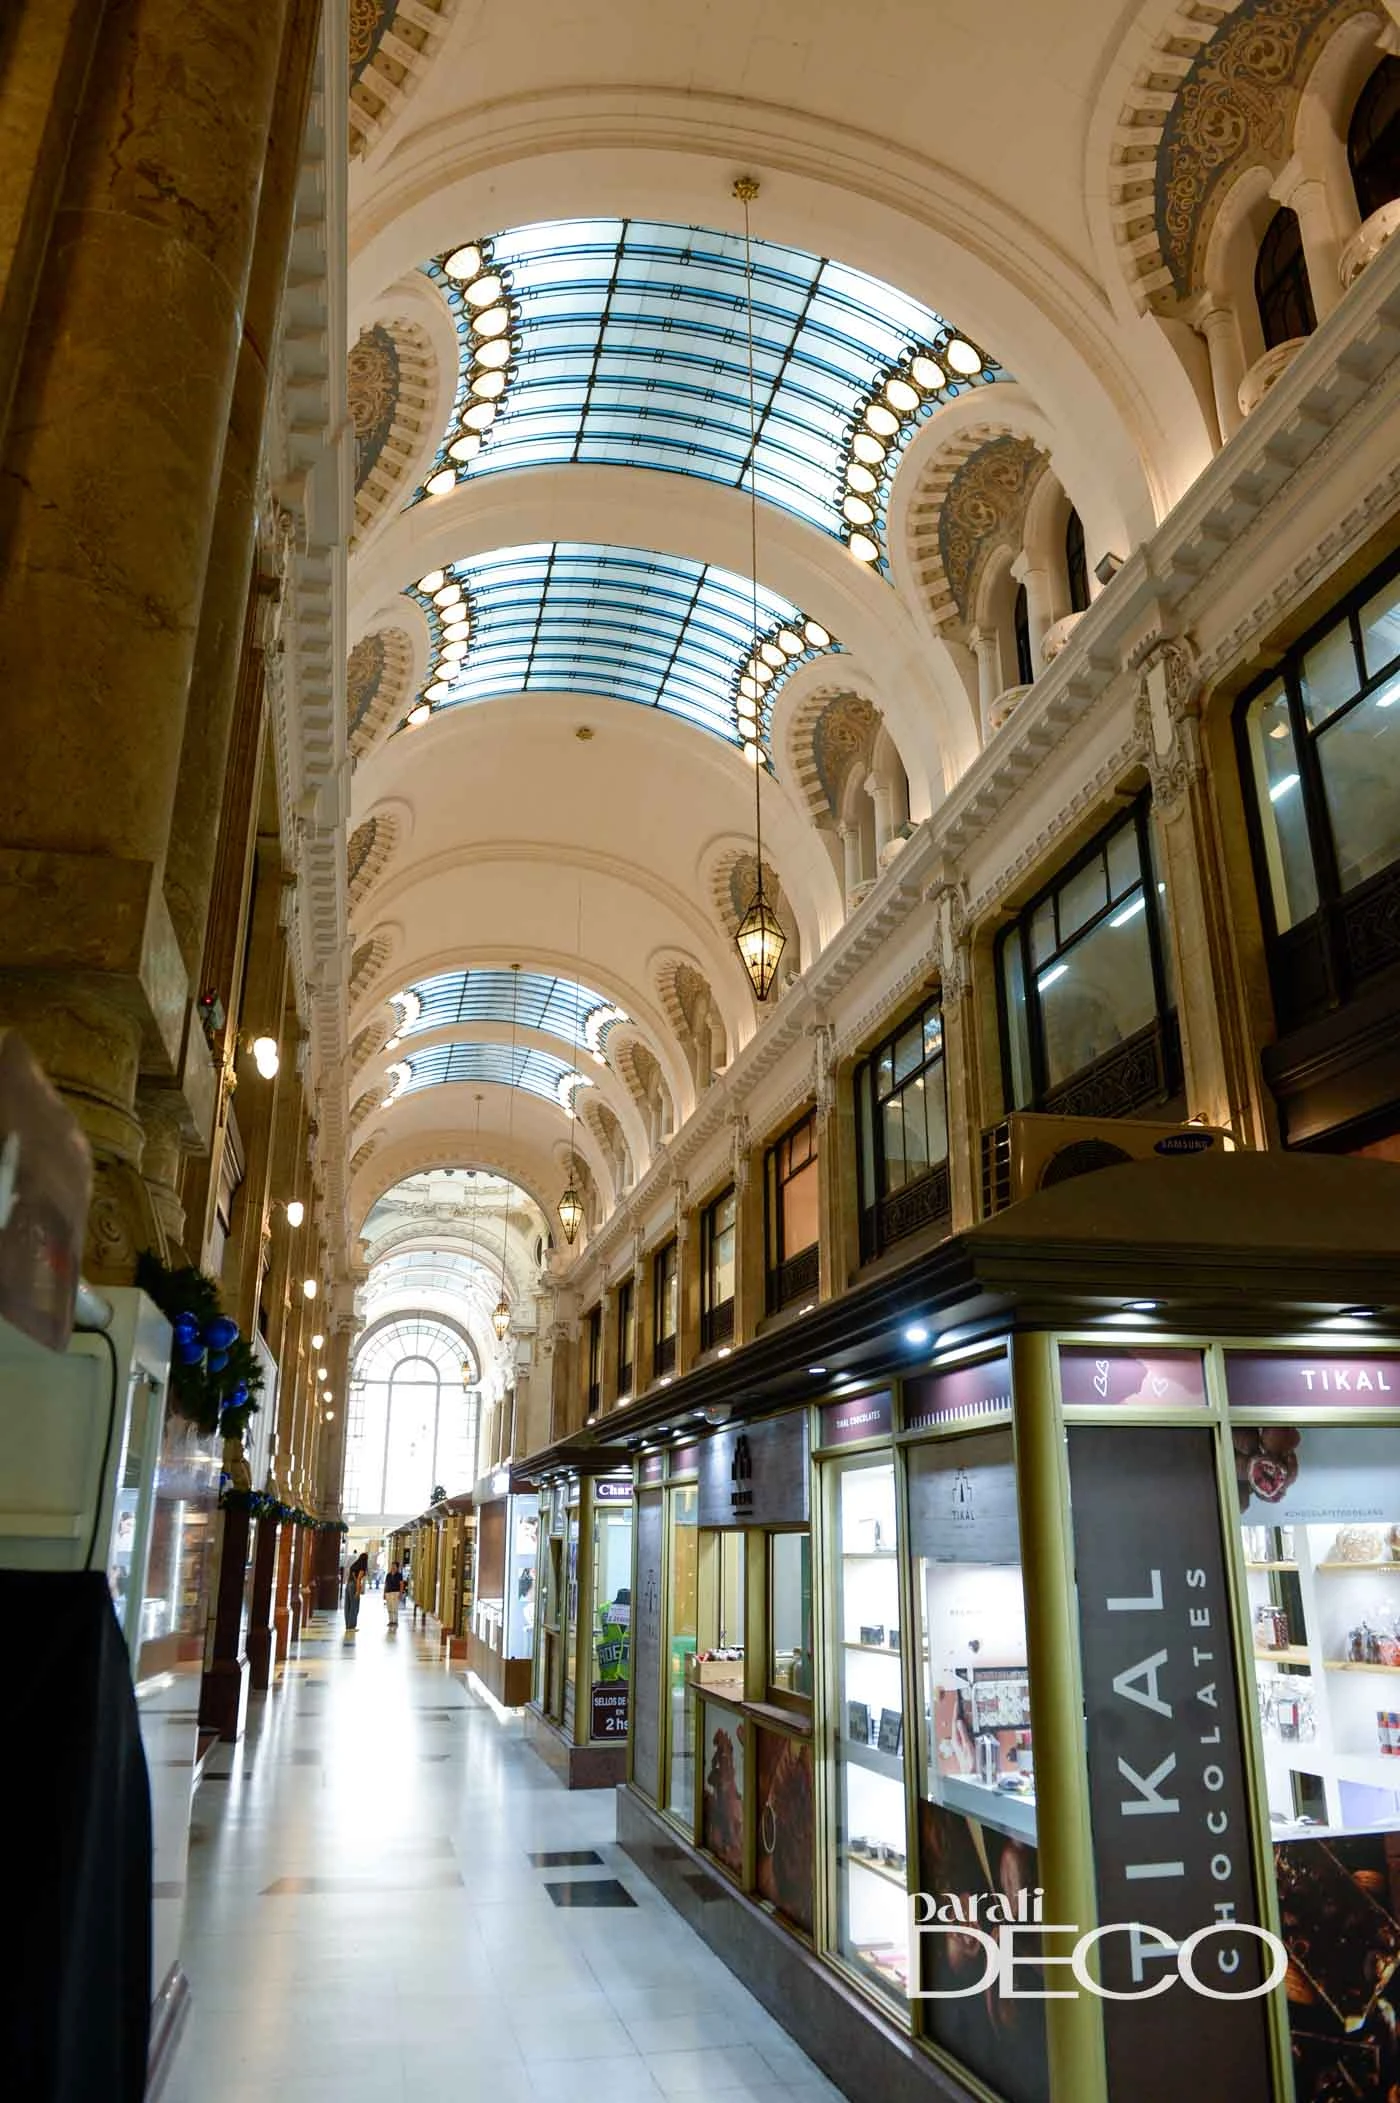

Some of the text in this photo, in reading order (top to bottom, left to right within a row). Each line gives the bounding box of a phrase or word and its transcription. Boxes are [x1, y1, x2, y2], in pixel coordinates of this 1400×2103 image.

[1161, 1139, 1208, 1151] SAMSUNG
[1300, 1369, 1392, 1392] TIKAL
[594, 1696, 626, 1706] SELLOS DE
[605, 1718, 615, 1730] 2
[1106, 1569, 1187, 1984] TIKAL
[1186, 1568, 1240, 1973] CHOCOLATES
